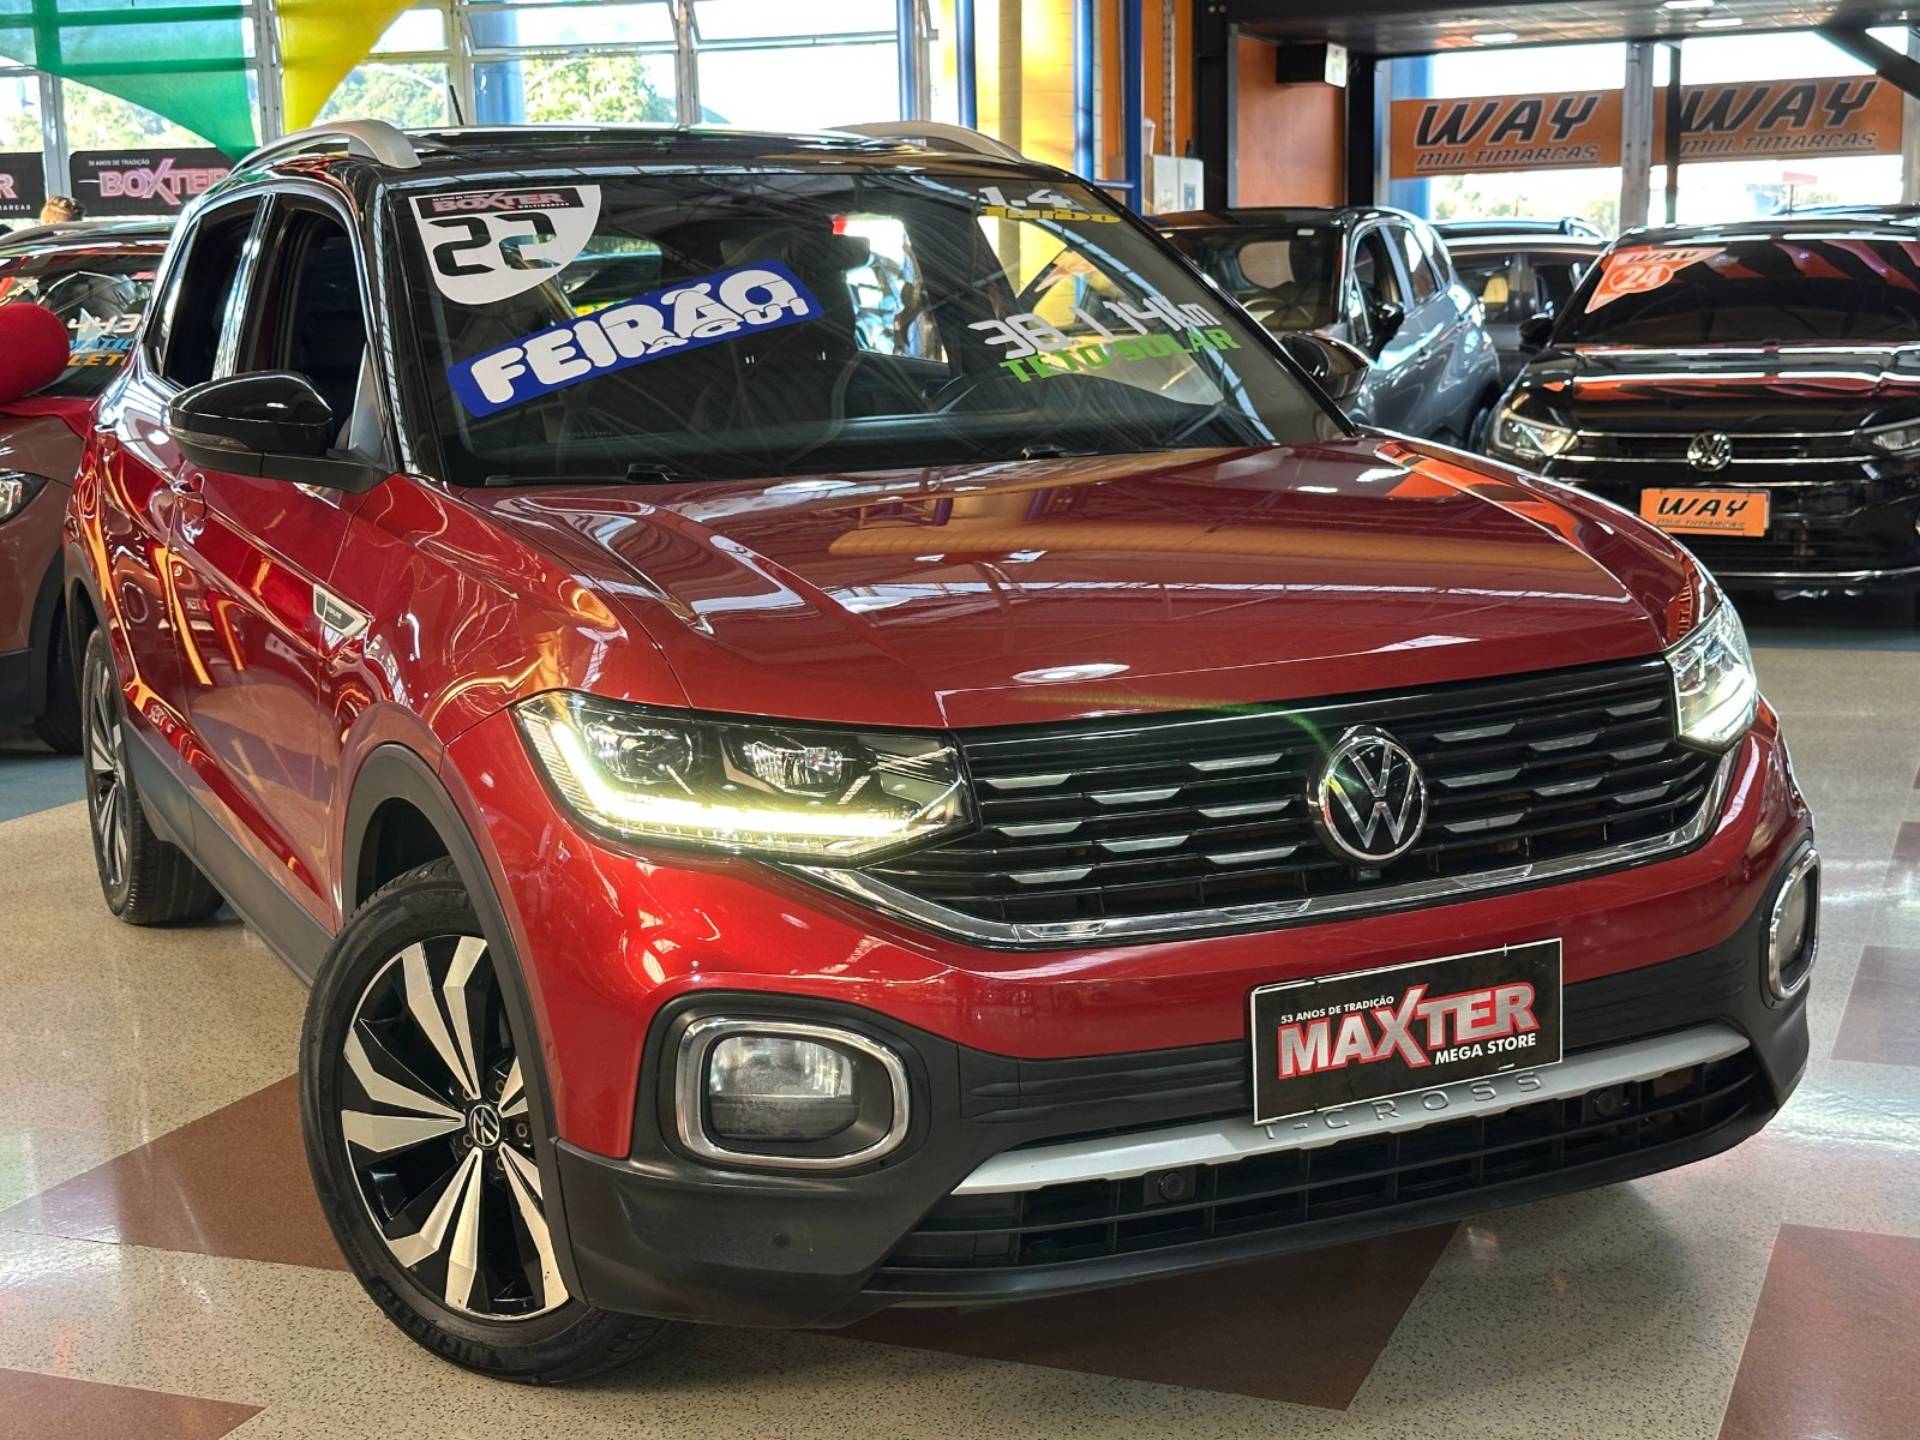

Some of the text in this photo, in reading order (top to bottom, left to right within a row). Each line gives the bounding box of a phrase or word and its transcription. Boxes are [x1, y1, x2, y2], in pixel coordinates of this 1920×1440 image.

[1413, 95, 1600, 148] WAY
[1680, 79, 1879, 136] WAY
[1416, 146, 1599, 166] MULTIMARCAS
[432, 192, 564, 213] BOXTER
[428, 212, 562, 277] 22
[470, 269, 809, 404] FEIRÃO
[1658, 497, 1749, 517] WAY
[1278, 982, 1541, 1080] MAXTER
[1281, 995, 1395, 1024] 53 ANOS DE TRADIÇÃO
[1435, 1032, 1537, 1065] MEGA STORE
